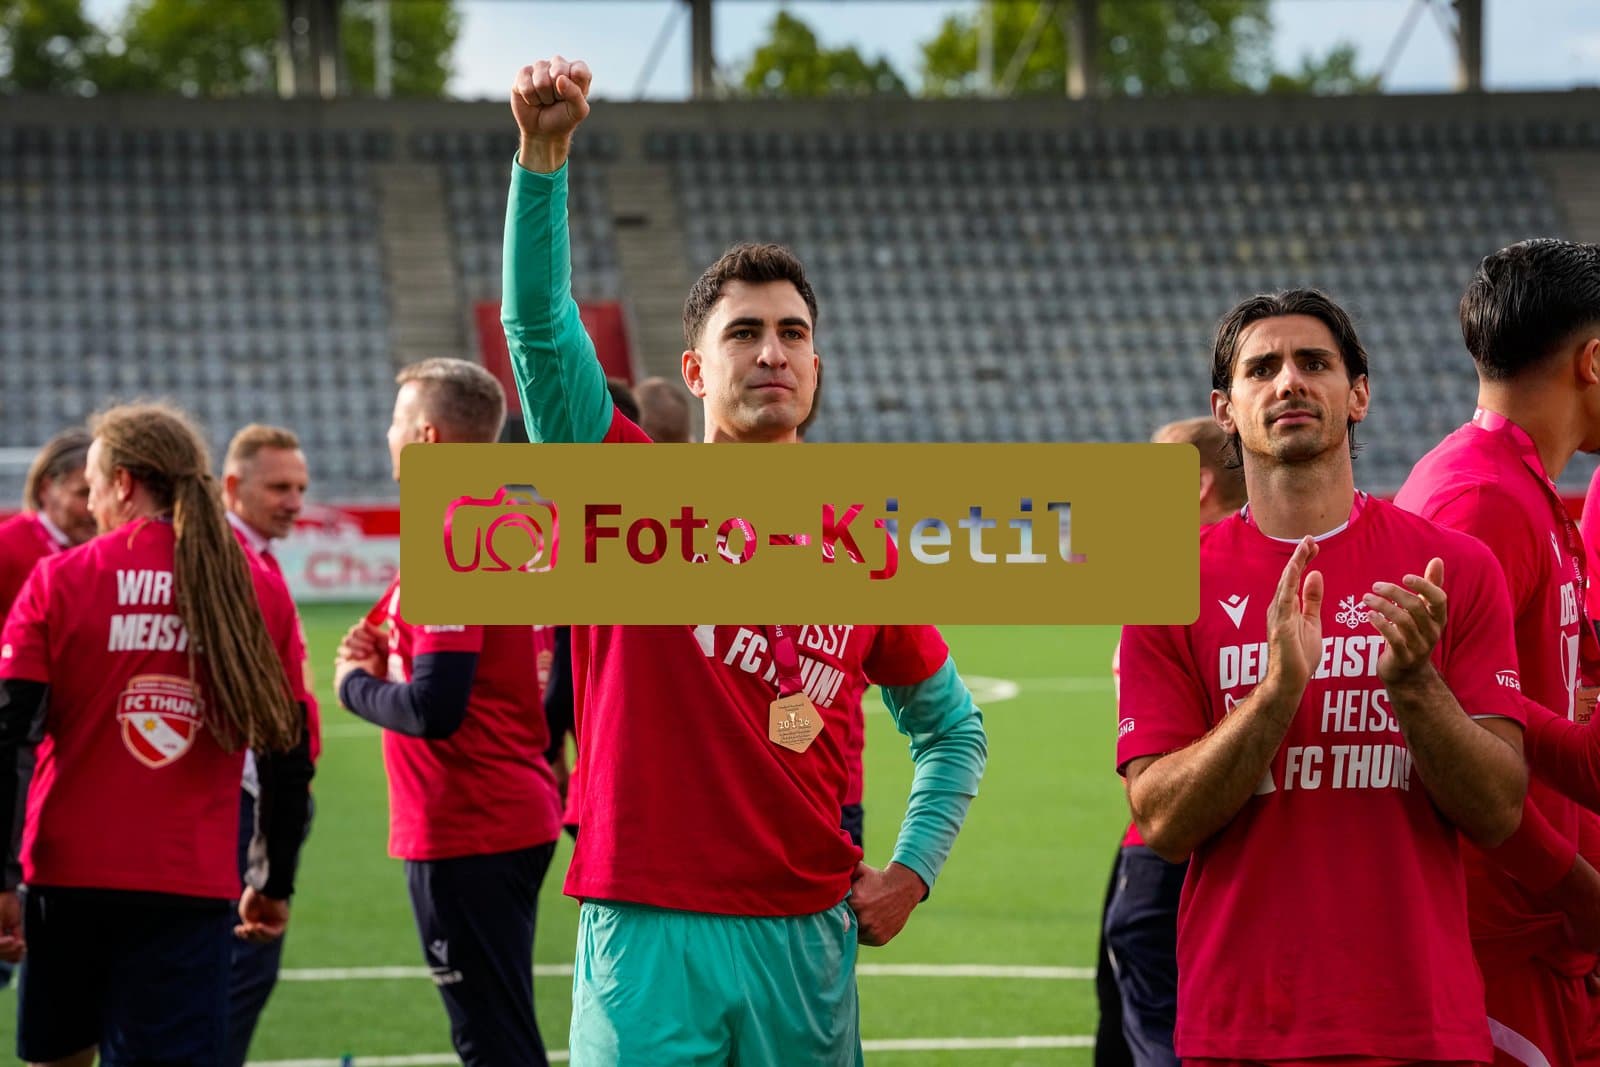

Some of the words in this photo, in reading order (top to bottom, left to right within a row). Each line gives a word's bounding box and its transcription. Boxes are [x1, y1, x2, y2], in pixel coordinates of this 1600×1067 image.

[116, 569, 173, 606] WIR
[1560, 581, 1579, 626] DE
[723, 627, 769, 674] FC
[1311, 635, 1385, 680] EIST
[125, 694, 146, 711] FC
[149, 695, 197, 717] THUN
[1284, 747, 1324, 790] FC
[1331, 744, 1412, 791] THUN!
